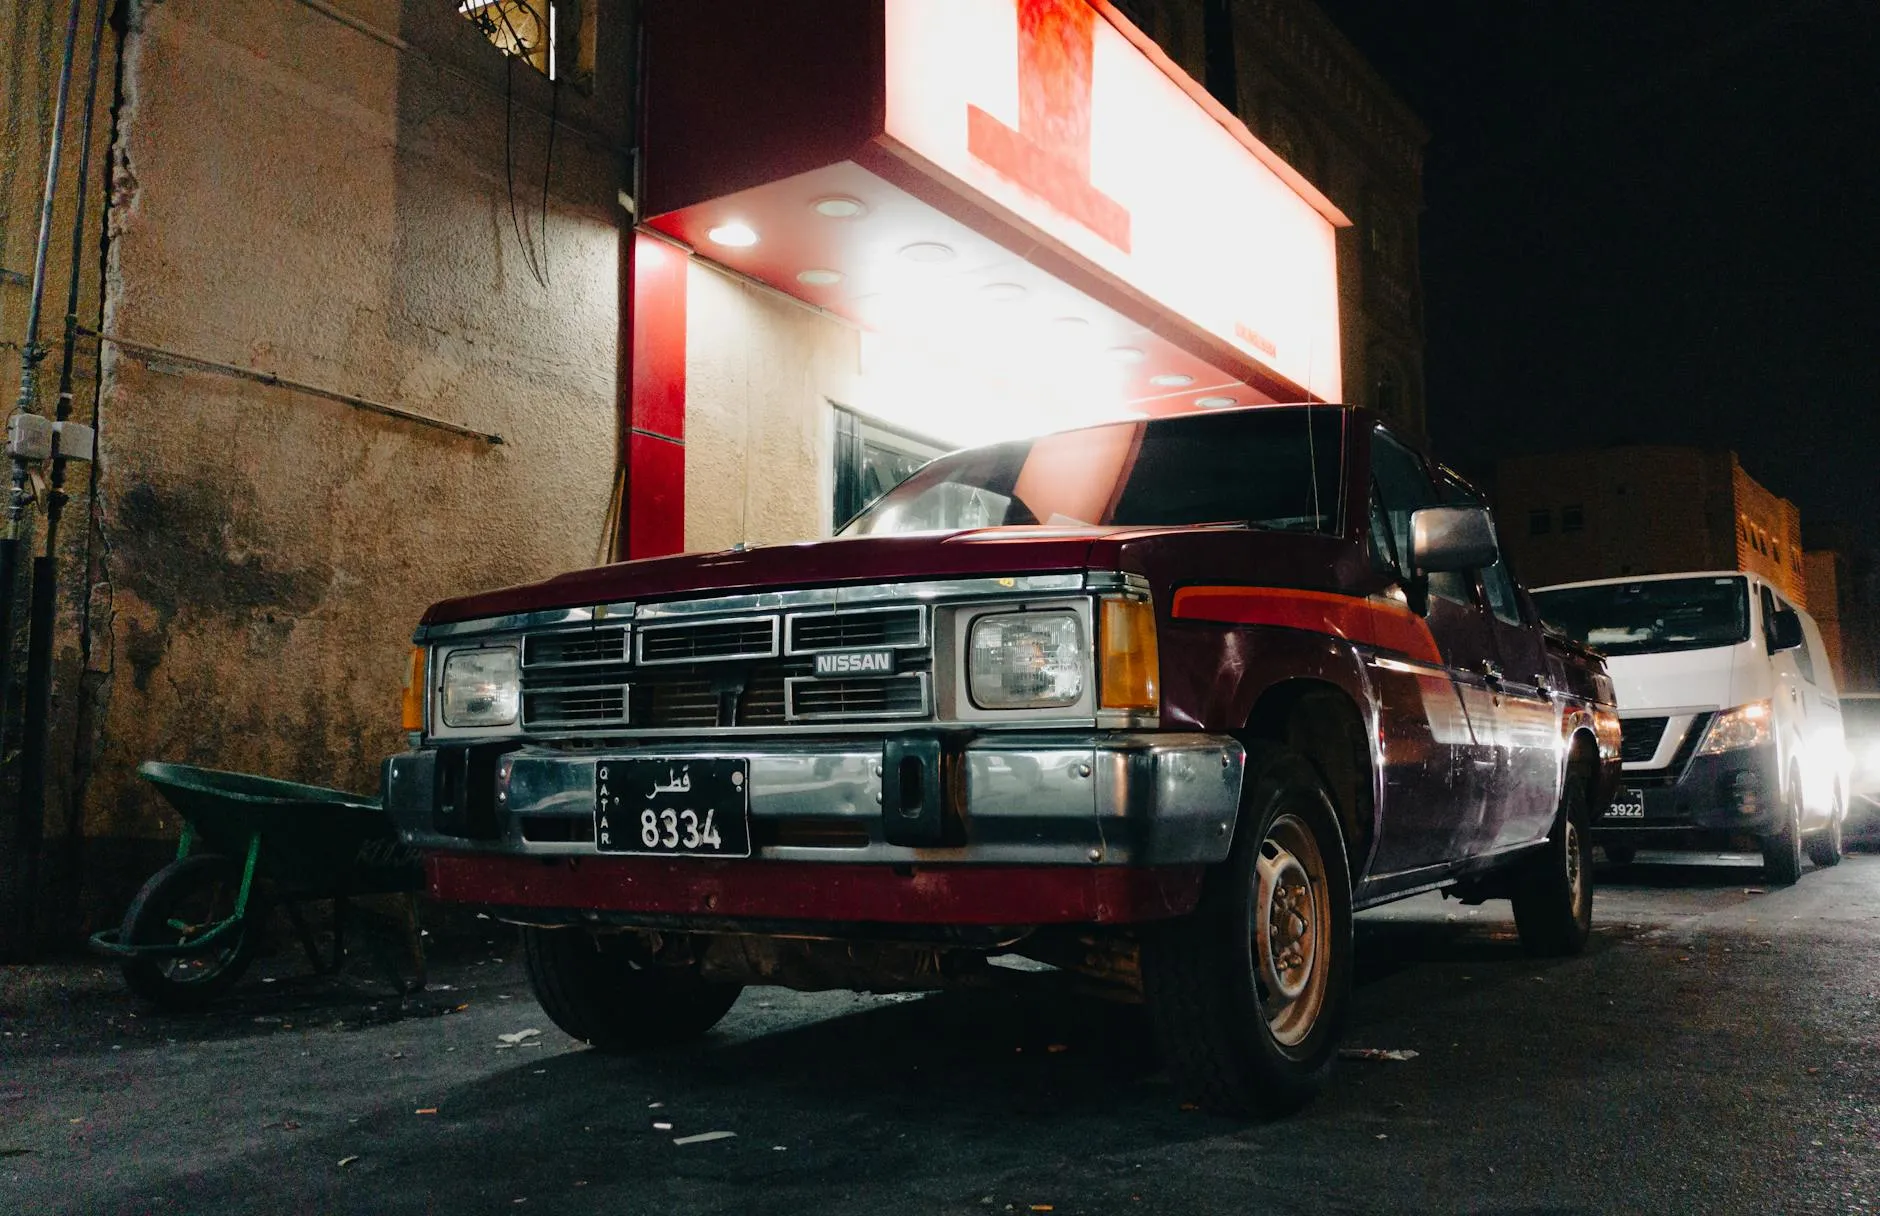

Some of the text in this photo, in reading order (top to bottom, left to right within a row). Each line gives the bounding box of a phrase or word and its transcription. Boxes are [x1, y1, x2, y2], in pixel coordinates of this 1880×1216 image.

[817, 653, 889, 673] NISSAN
[645, 764, 691, 799] قطر
[600, 766, 611, 845] QATAR
[1604, 803, 1642, 816] 3922
[641, 808, 721, 849] 8334
